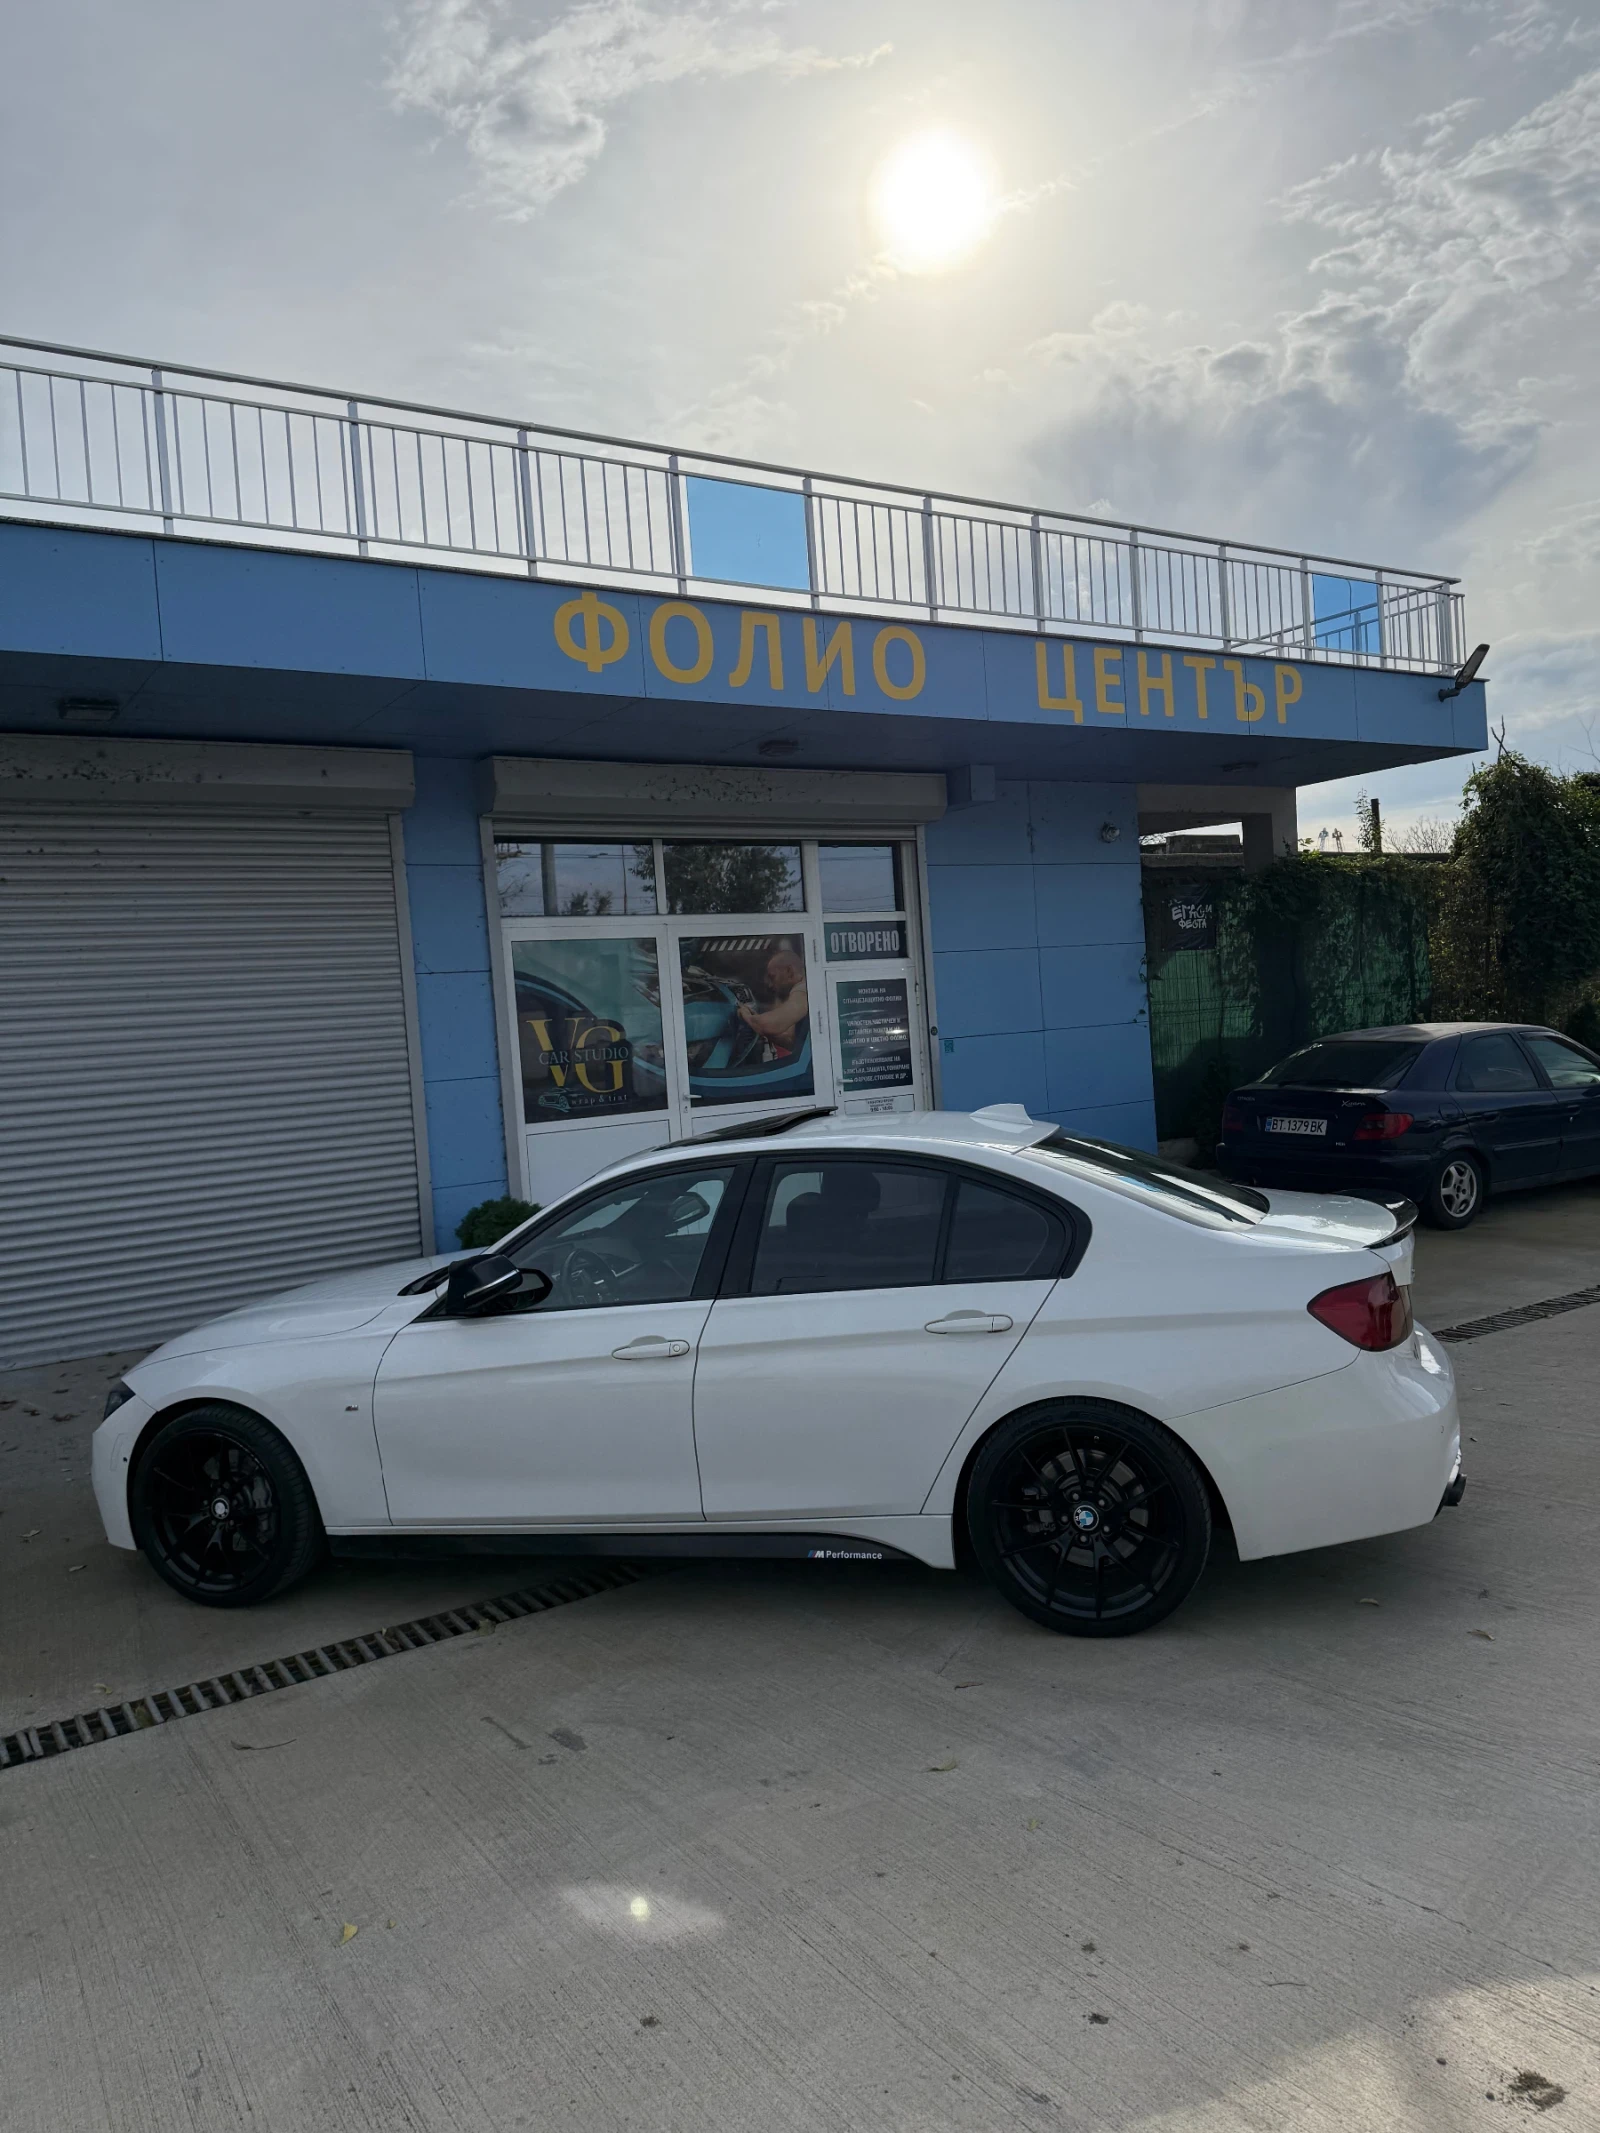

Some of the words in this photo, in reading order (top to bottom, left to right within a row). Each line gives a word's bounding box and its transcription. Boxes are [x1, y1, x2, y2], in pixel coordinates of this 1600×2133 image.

[553, 591, 926, 700] ФОЛИО
[1036, 640, 1304, 725] ЦЕНТЪР
[830, 930, 900, 953] ОТВОРЕНО
[525, 1017, 628, 1093] VG
[538, 1050, 570, 1065] CAR
[574, 1046, 629, 1063] STUDIO
[598, 1094, 605, 1103] &
[814, 1550, 825, 1559] M
[826, 1550, 883, 1560] Performance
